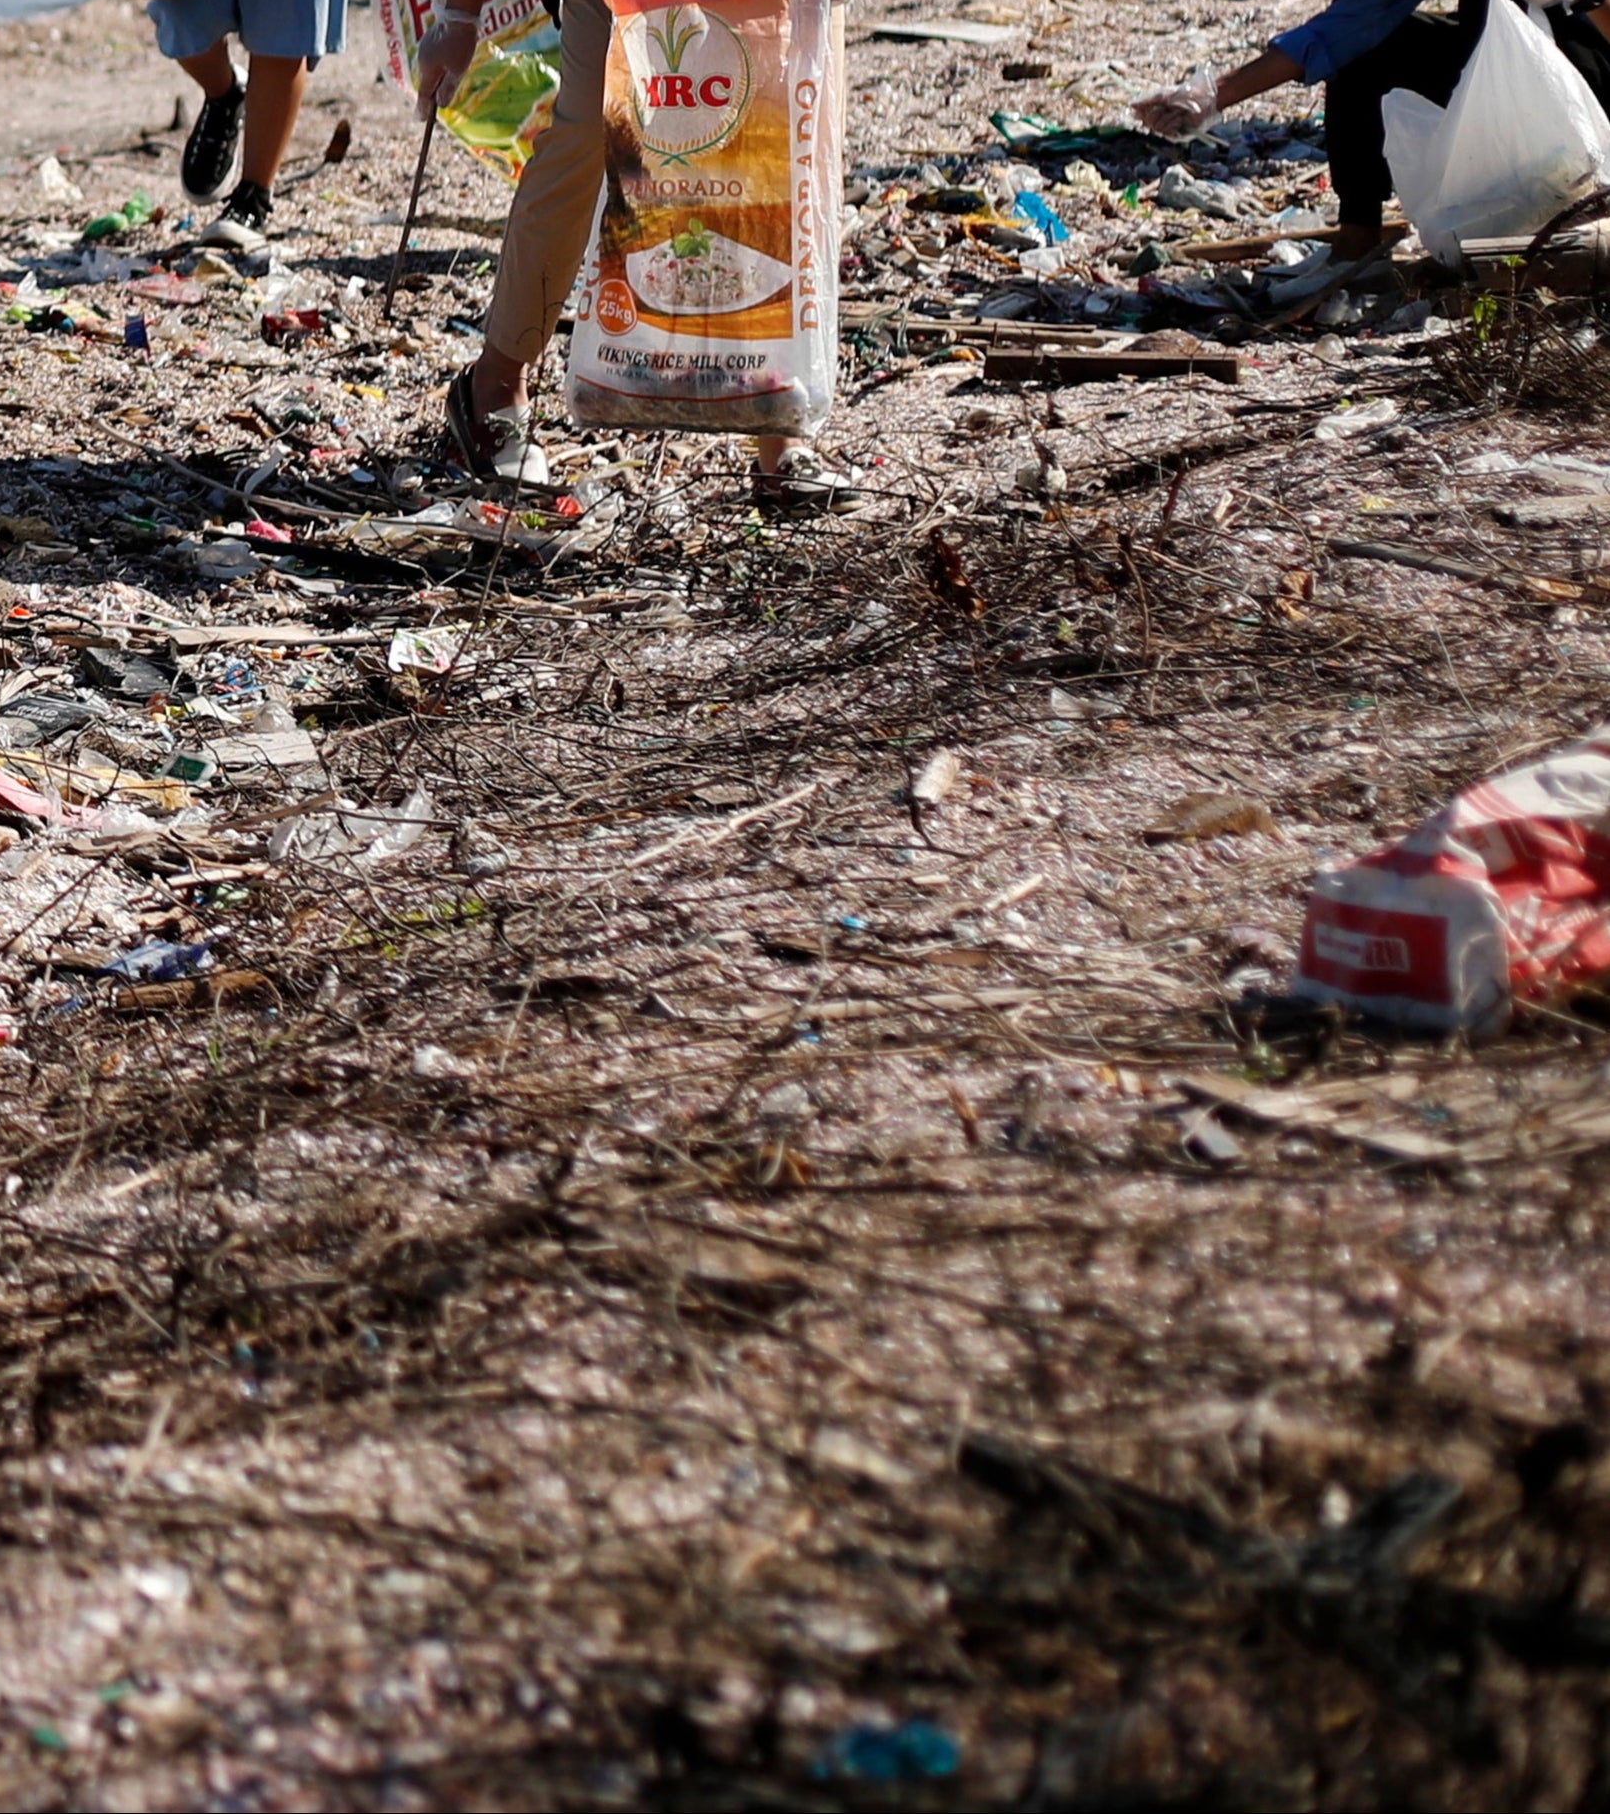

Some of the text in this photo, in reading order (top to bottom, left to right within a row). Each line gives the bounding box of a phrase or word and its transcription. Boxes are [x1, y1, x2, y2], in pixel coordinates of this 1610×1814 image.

[600, 299, 633, 325] 25kg
[596, 344, 767, 370] VIKINGS RICE MILL CORP
